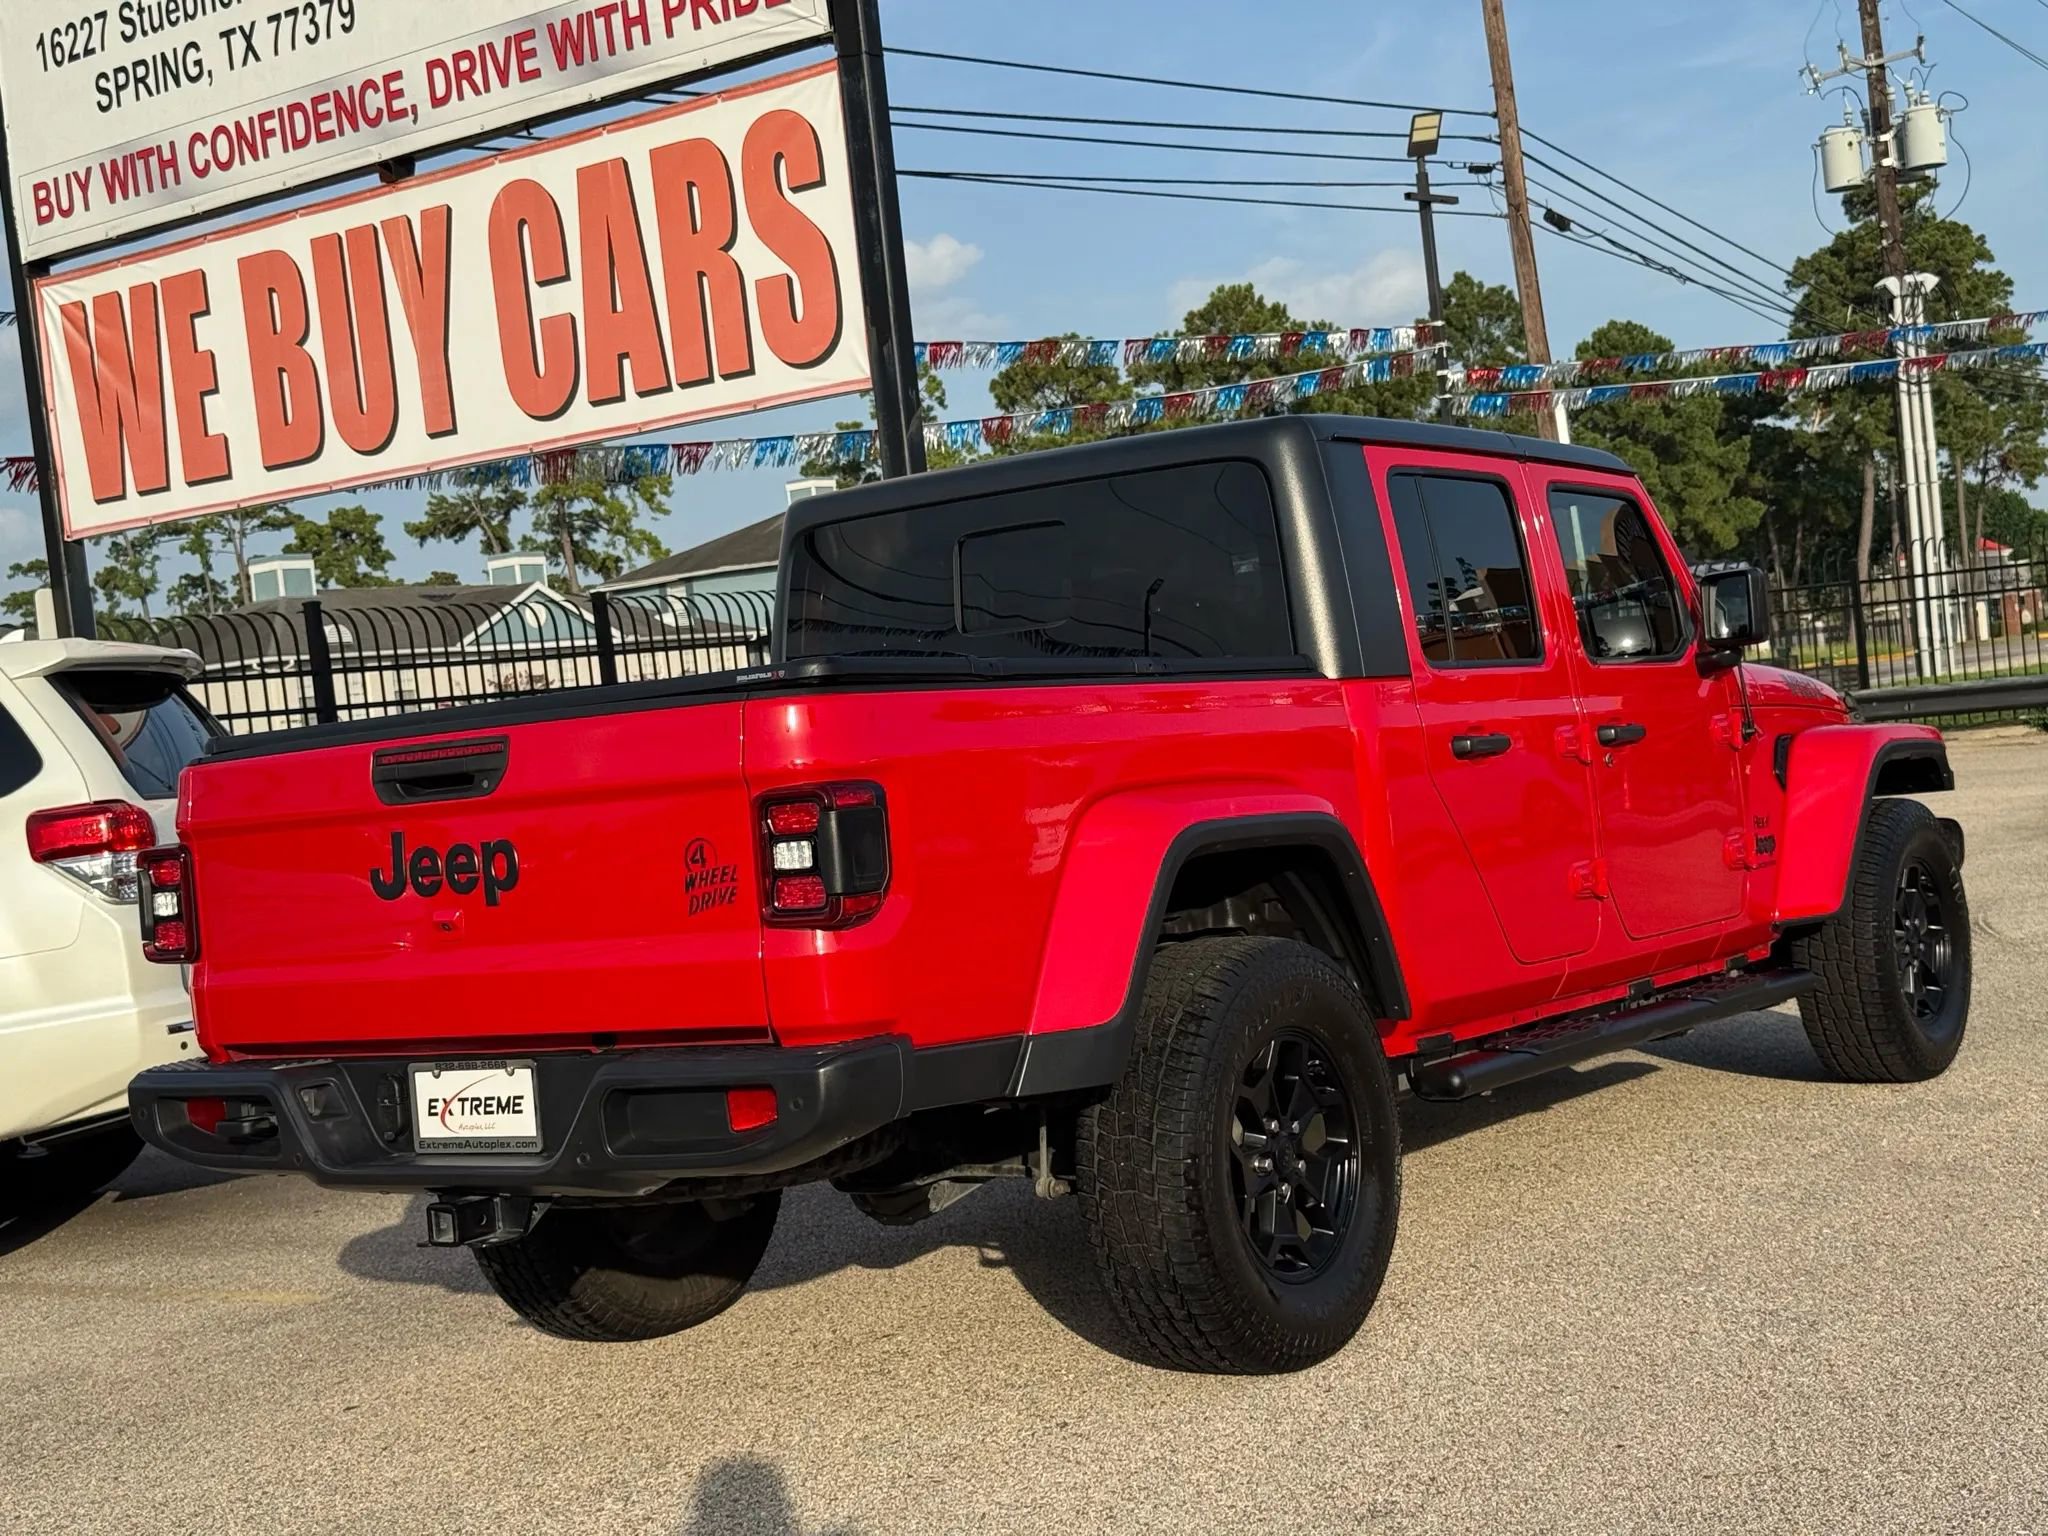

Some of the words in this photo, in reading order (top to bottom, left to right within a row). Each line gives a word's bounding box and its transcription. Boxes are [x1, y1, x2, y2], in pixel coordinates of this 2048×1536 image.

[36, 10, 108, 72] 16227
[118, 0, 242, 43] Stuebn
[95, 41, 214, 113] SPRING,
[219, 20, 262, 71] TX
[267, 0, 357, 57] 77379
[32, 166, 93, 226] BUY
[99, 141, 181, 205] WITH
[188, 70, 418, 179] CONFIDENCE,
[426, 29, 542, 108] DRIVE
[547, 5, 651, 72] WITH
[662, 0, 791, 39] PRI
[60, 268, 231, 504] WE
[237, 204, 457, 472] BUY
[488, 109, 842, 421] CARS
[370, 831, 519, 906] Jeep
[685, 865, 737, 894] WHEEL
[688, 887, 737, 917] DRIVE
[428, 1095, 524, 1116] EXTREME
[418, 1140, 537, 1150] ExtremeAutoplex.com
